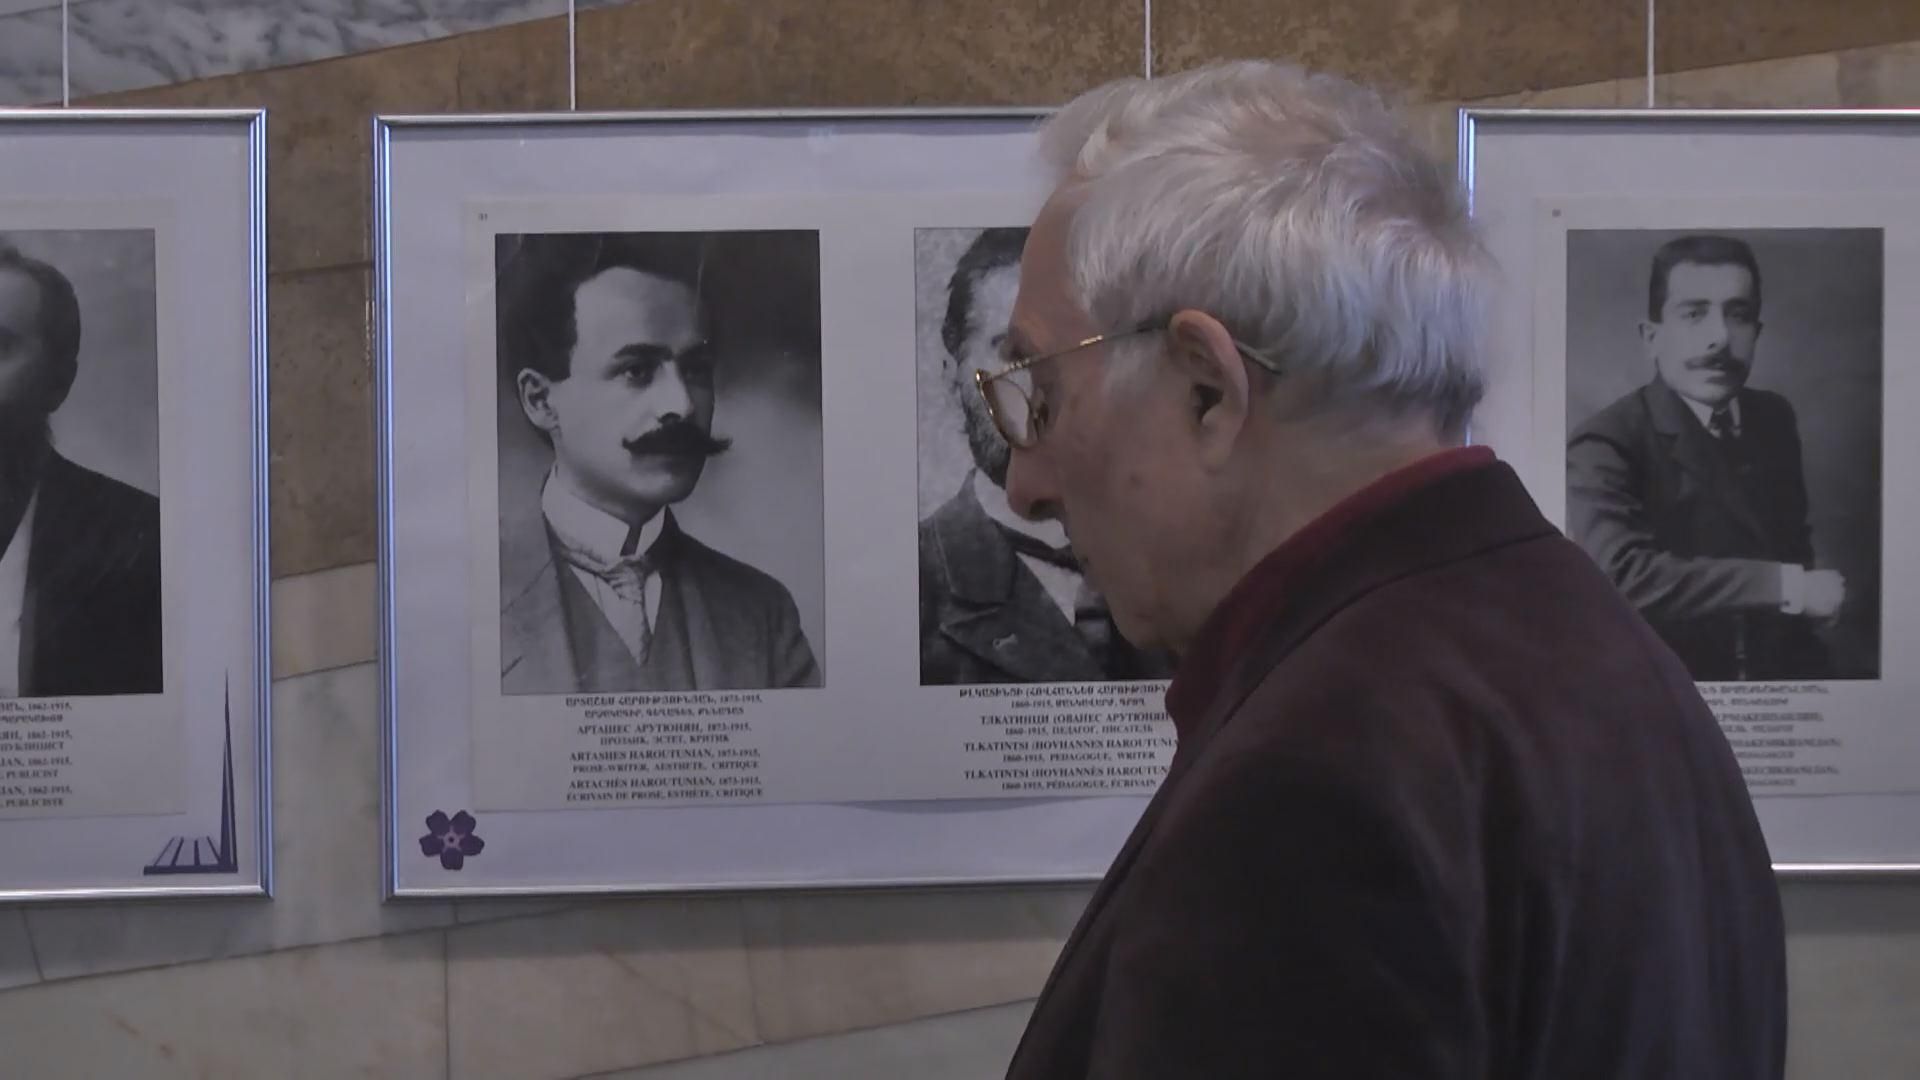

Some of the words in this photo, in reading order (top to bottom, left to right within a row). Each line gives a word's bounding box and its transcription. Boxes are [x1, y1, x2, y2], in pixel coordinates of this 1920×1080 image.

[979, 715, 1048, 725] ТЛКАТИНЦИ
[1053, 713, 1101, 724] (ОВАНЕС
[577, 725, 630, 735] АРТАШЕС
[635, 723, 702, 733] АРУТЮНЯН,
[1052, 726, 1099, 735] ПЕДАГОГ,
[1101, 725, 1153, 733] ПИСАТЕЛЬ
[600, 737, 649, 745] ПРОЗАИК,
[689, 734, 729, 743] КРИТИК
[964, 741, 1028, 752] TLKATINTSI
[1032, 740, 1104, 750] (HOVHANNES
[569, 751, 626, 760] ARTASHES
[629, 749, 714, 760] HAROUTUNIAN,
[1050, 753, 1112, 761] PEDAGOGUE,
[1117, 751, 1155, 760] WRITER
[573, 764, 649, 773] PROSE-WRITER,
[654, 762, 706, 771] AESTHETE,
[712, 760, 758, 770] CRITIQUE
[6, 769, 58, 779] PUBLICIST
[964, 769, 1028, 779] TLKATINTSI
[630, 776, 715, 787] HAROUTUNIAN,
[615, 791, 627, 800] DE
[630, 790, 666, 800] PROSE,
[716, 787, 762, 797] CRITIQUE
[6, 798, 63, 808] PUBLICISTE
